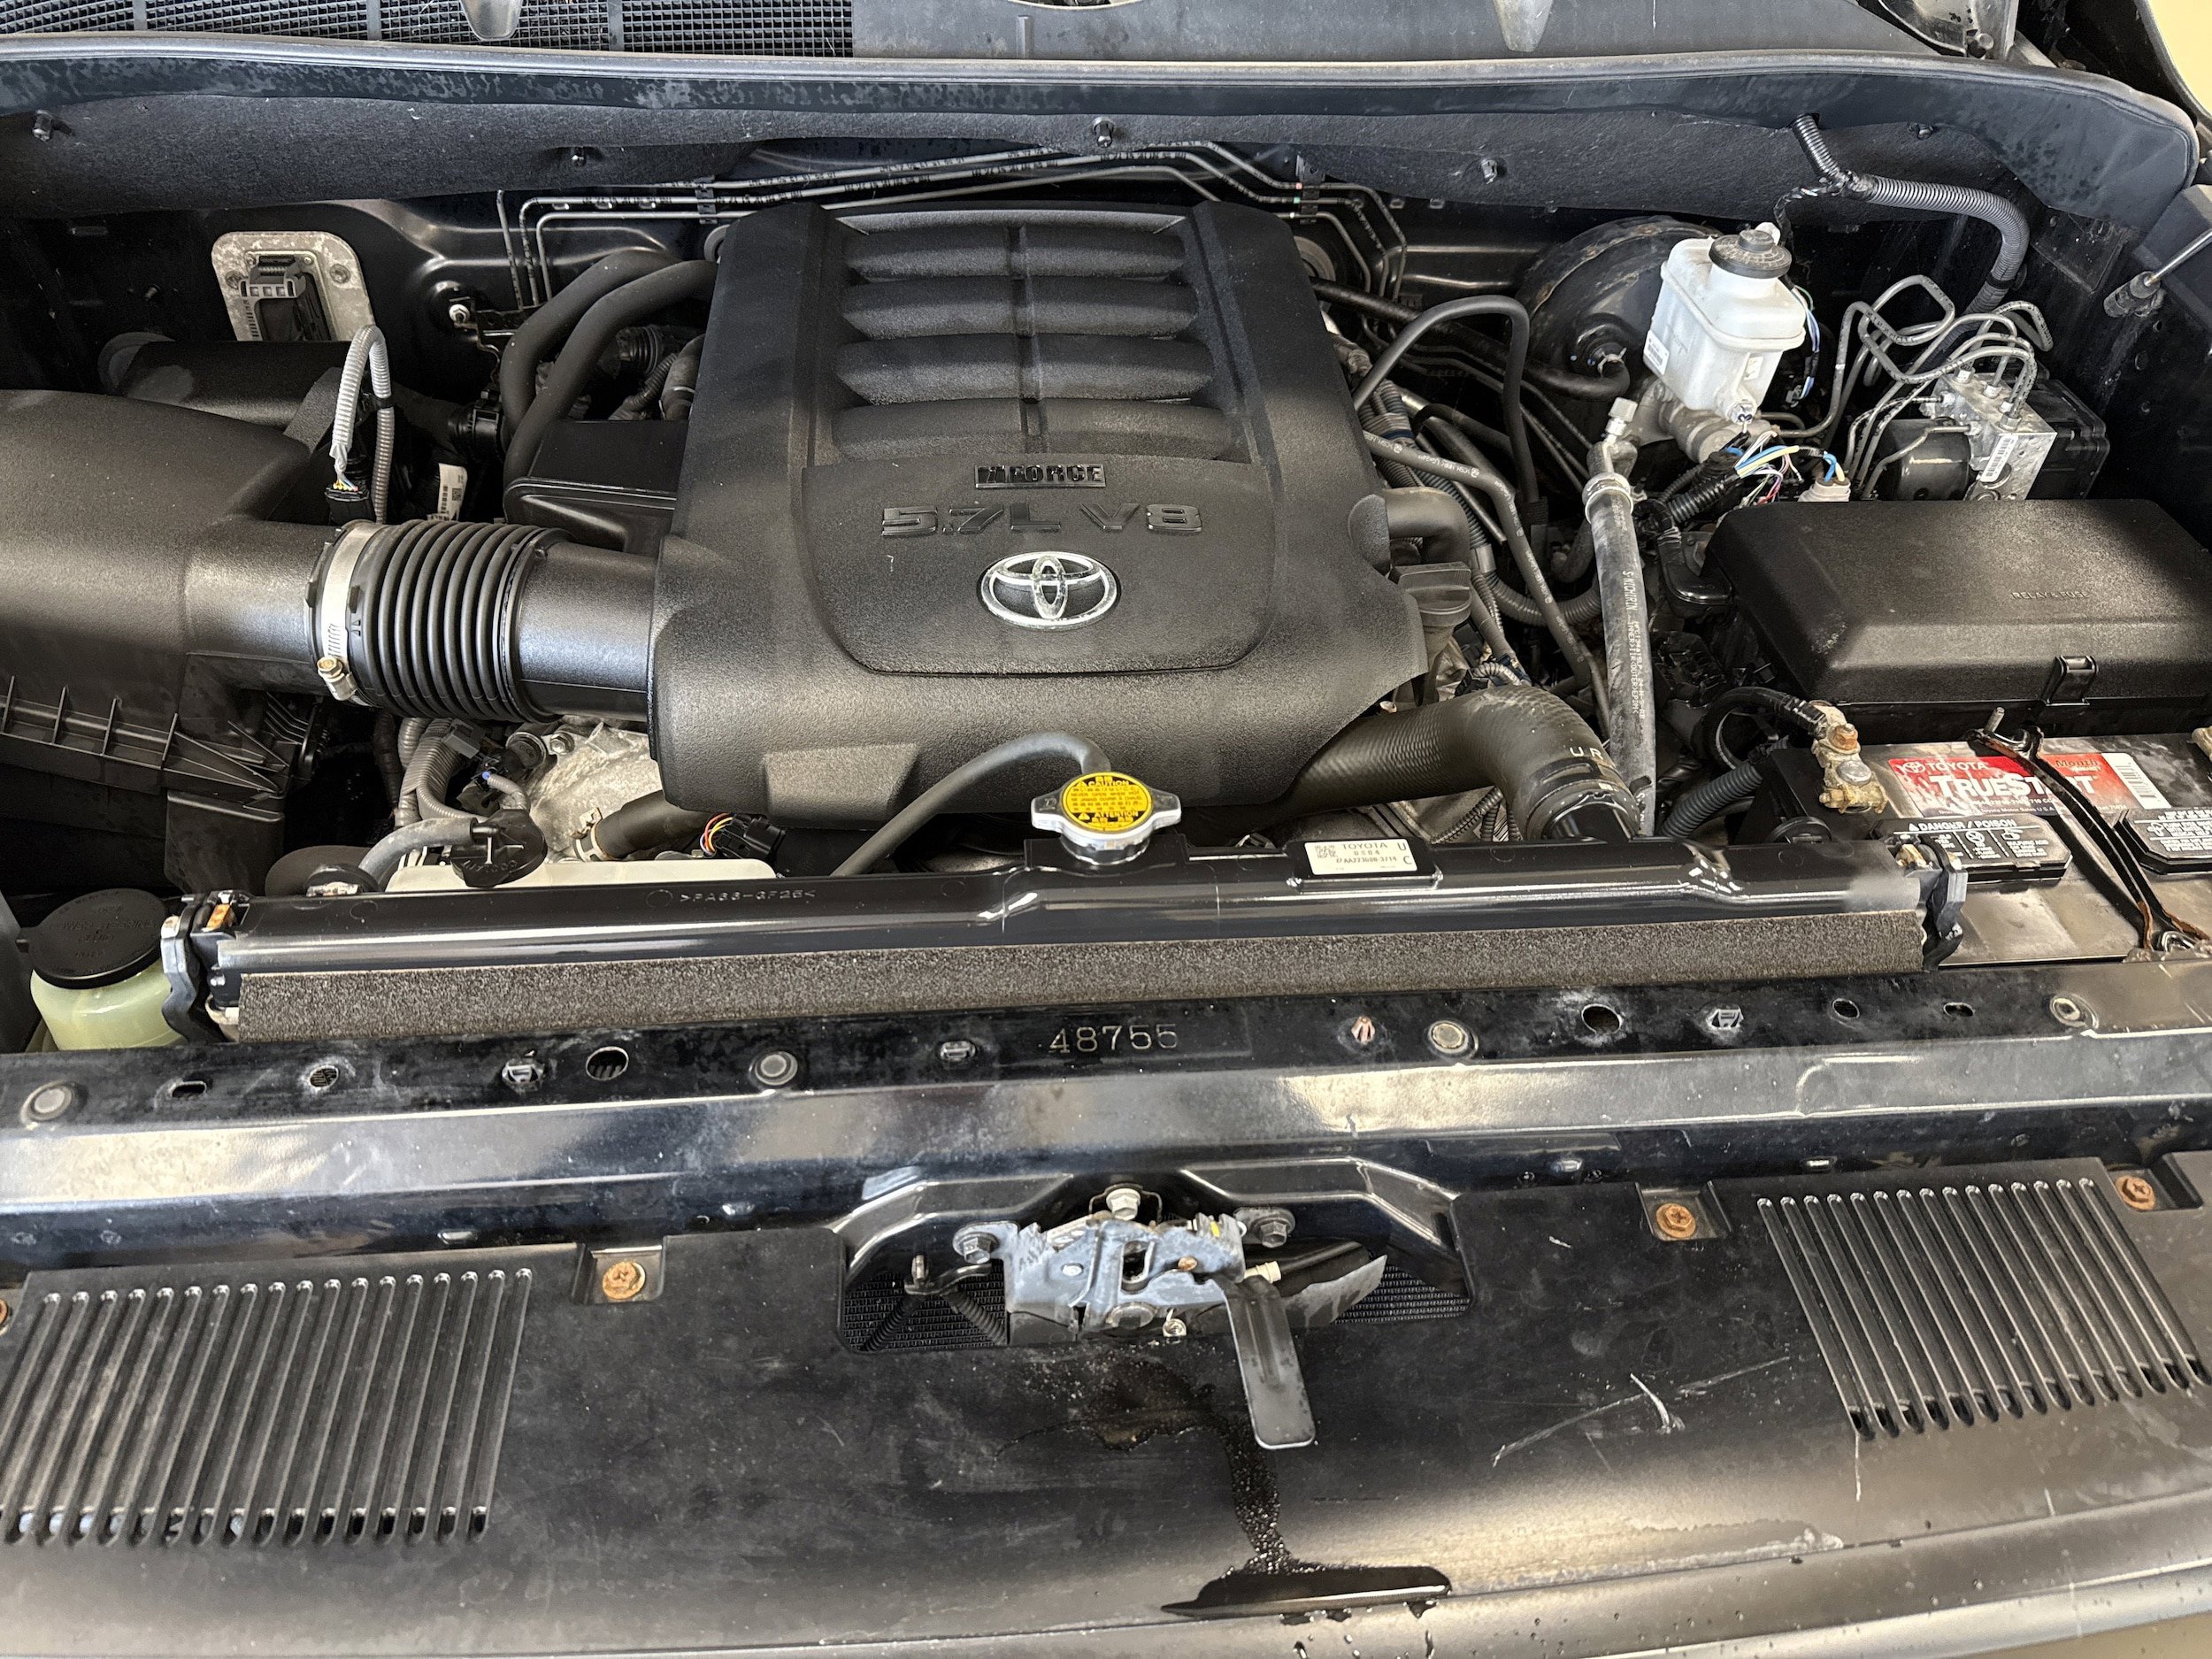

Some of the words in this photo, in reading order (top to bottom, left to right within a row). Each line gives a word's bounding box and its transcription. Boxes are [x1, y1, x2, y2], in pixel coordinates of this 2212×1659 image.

[1079, 501, 1202, 533] V8
[2011, 591, 2049, 600] RELAY
[2060, 590, 2089, 599] FUSE
[1926, 761, 1988, 772] TOYOTA
[2055, 759, 2099, 768] Month
[1918, 821, 1966, 831] DANGER
[1973, 818, 2017, 828] POISON
[1342, 841, 1388, 850] TOYOTA
[1397, 841, 1407, 851] U
[1402, 856, 1413, 865] C
[1048, 1023, 1179, 1054] 48755
